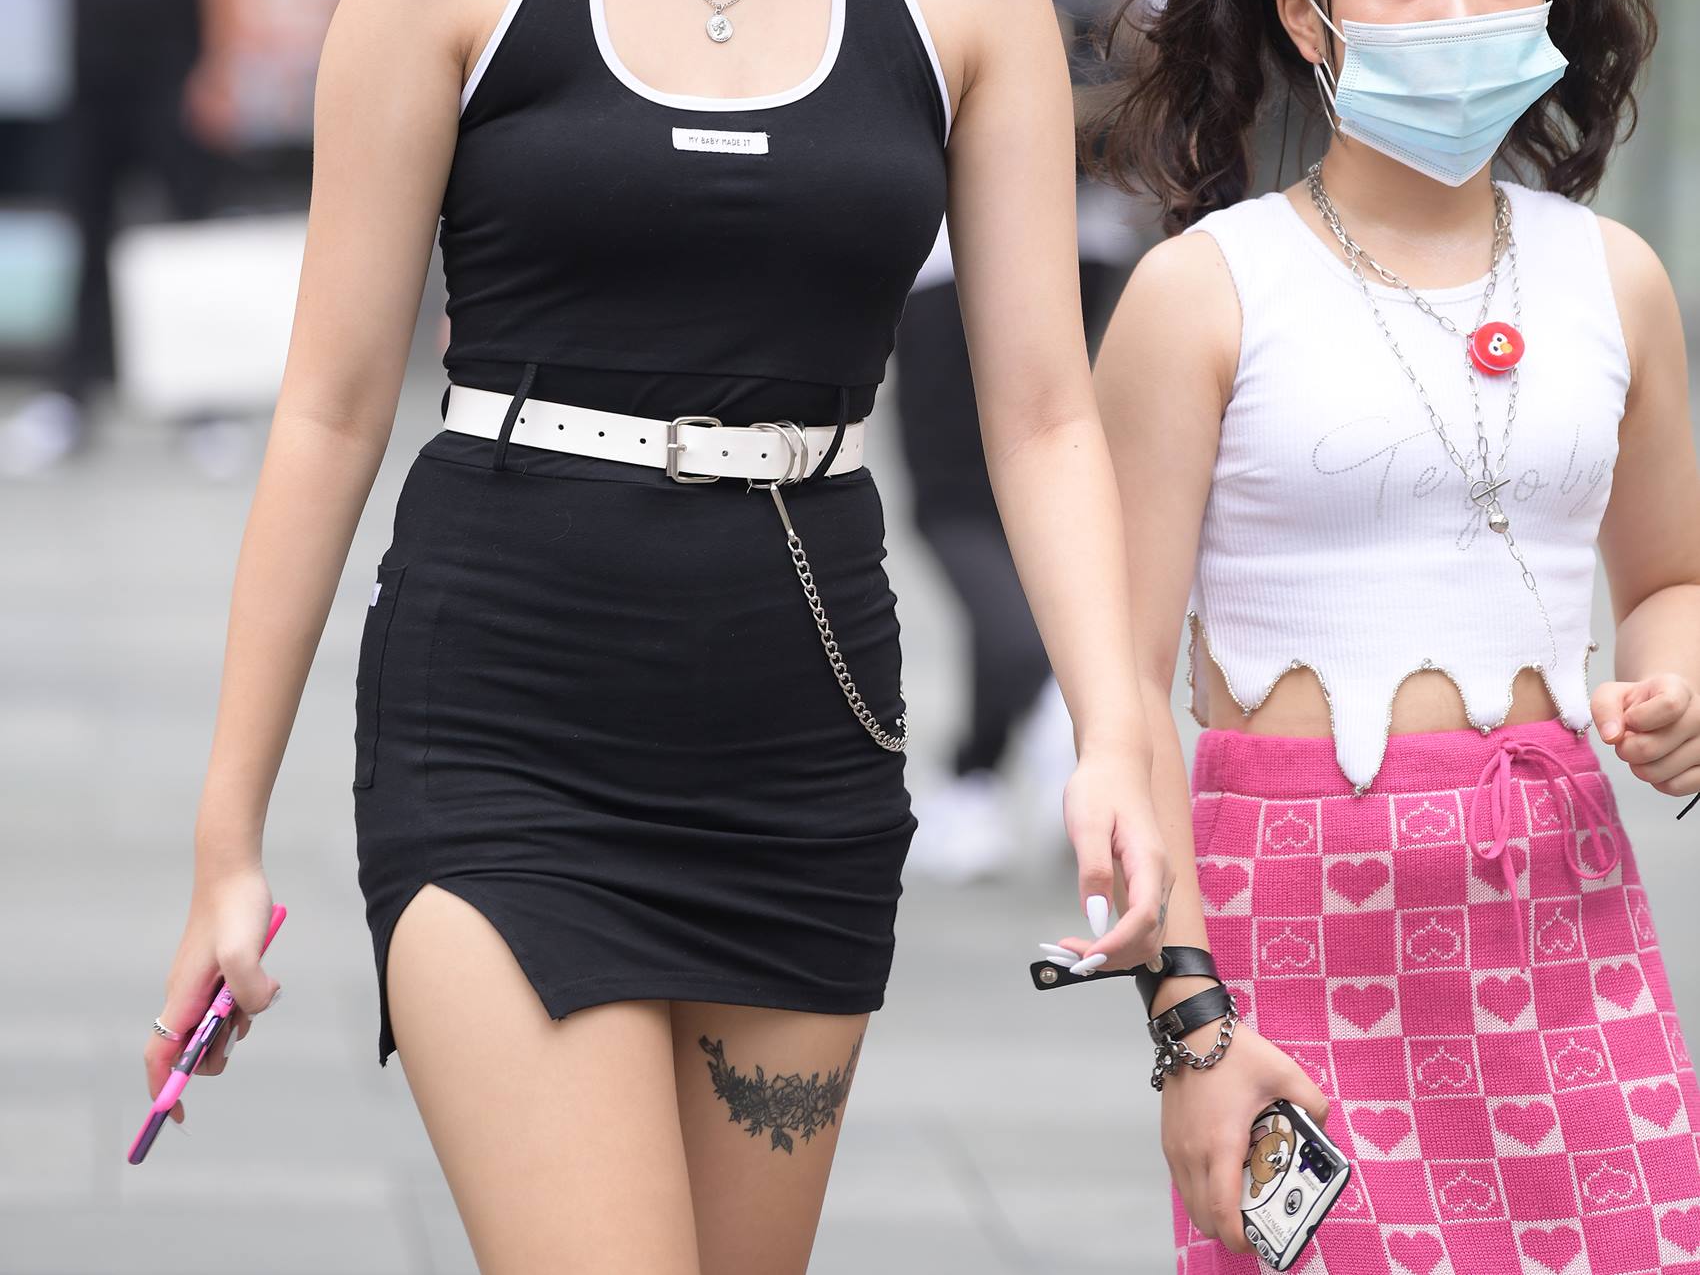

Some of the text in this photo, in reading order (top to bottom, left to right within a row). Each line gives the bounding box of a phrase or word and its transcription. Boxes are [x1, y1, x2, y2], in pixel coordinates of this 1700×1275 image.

[688, 136, 699, 144] MY
[701, 136, 720, 145] BABY
[721, 138, 741, 146] MADE
